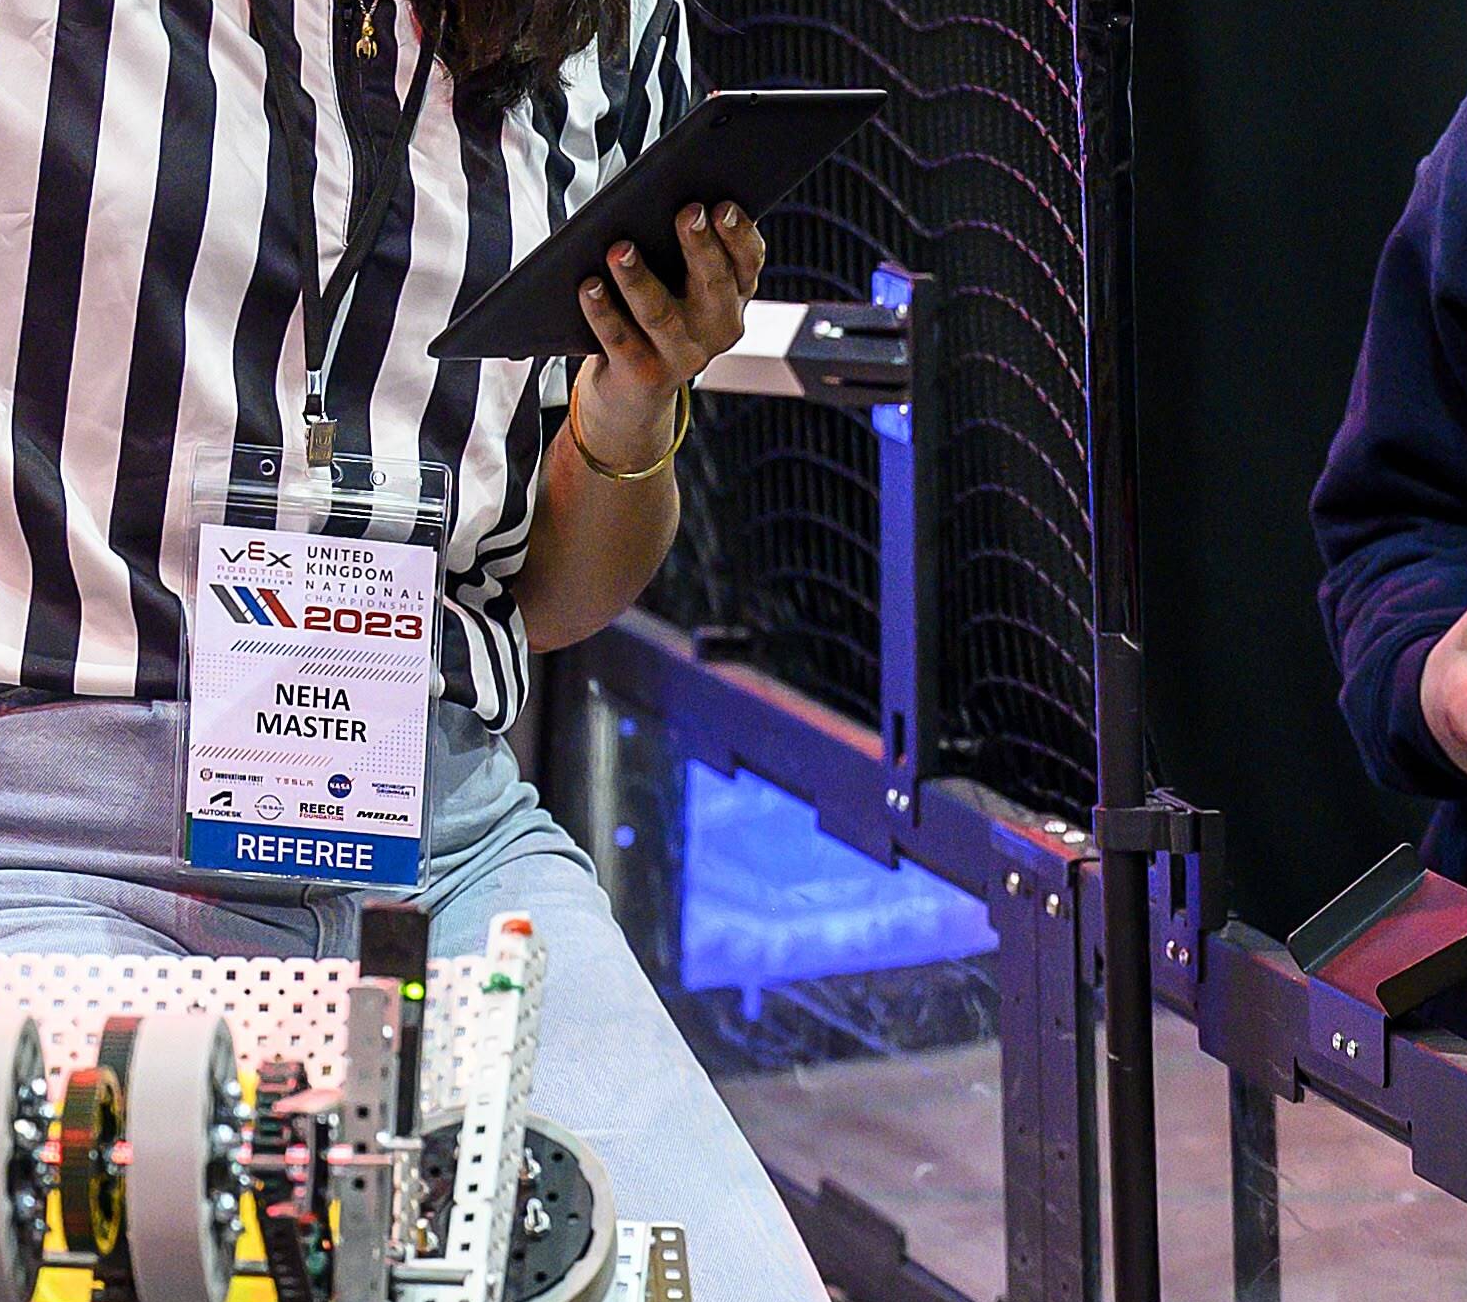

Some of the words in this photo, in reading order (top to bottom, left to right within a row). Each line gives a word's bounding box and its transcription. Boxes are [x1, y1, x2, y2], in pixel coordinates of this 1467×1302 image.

[219, 541, 292, 569] VEX
[307, 545, 374, 564] UNITED
[217, 564, 293, 578] ROBOTICS
[306, 562, 393, 582] KINGDOM
[305, 580, 424, 600] NATIONAL
[305, 594, 424, 611] CHAMPIONSHIP
[304, 606, 422, 640] 2023
[274, 682, 351, 711] NEHA
[256, 712, 367, 743] MASTER
[329, 782, 350, 790] NASA
[198, 808, 242, 818] AUTODESK
[299, 802, 344, 816] REECE
[299, 813, 344, 821] FOUNDATION
[356, 810, 409, 822] MBDA
[236, 833, 374, 871] REFEREE
